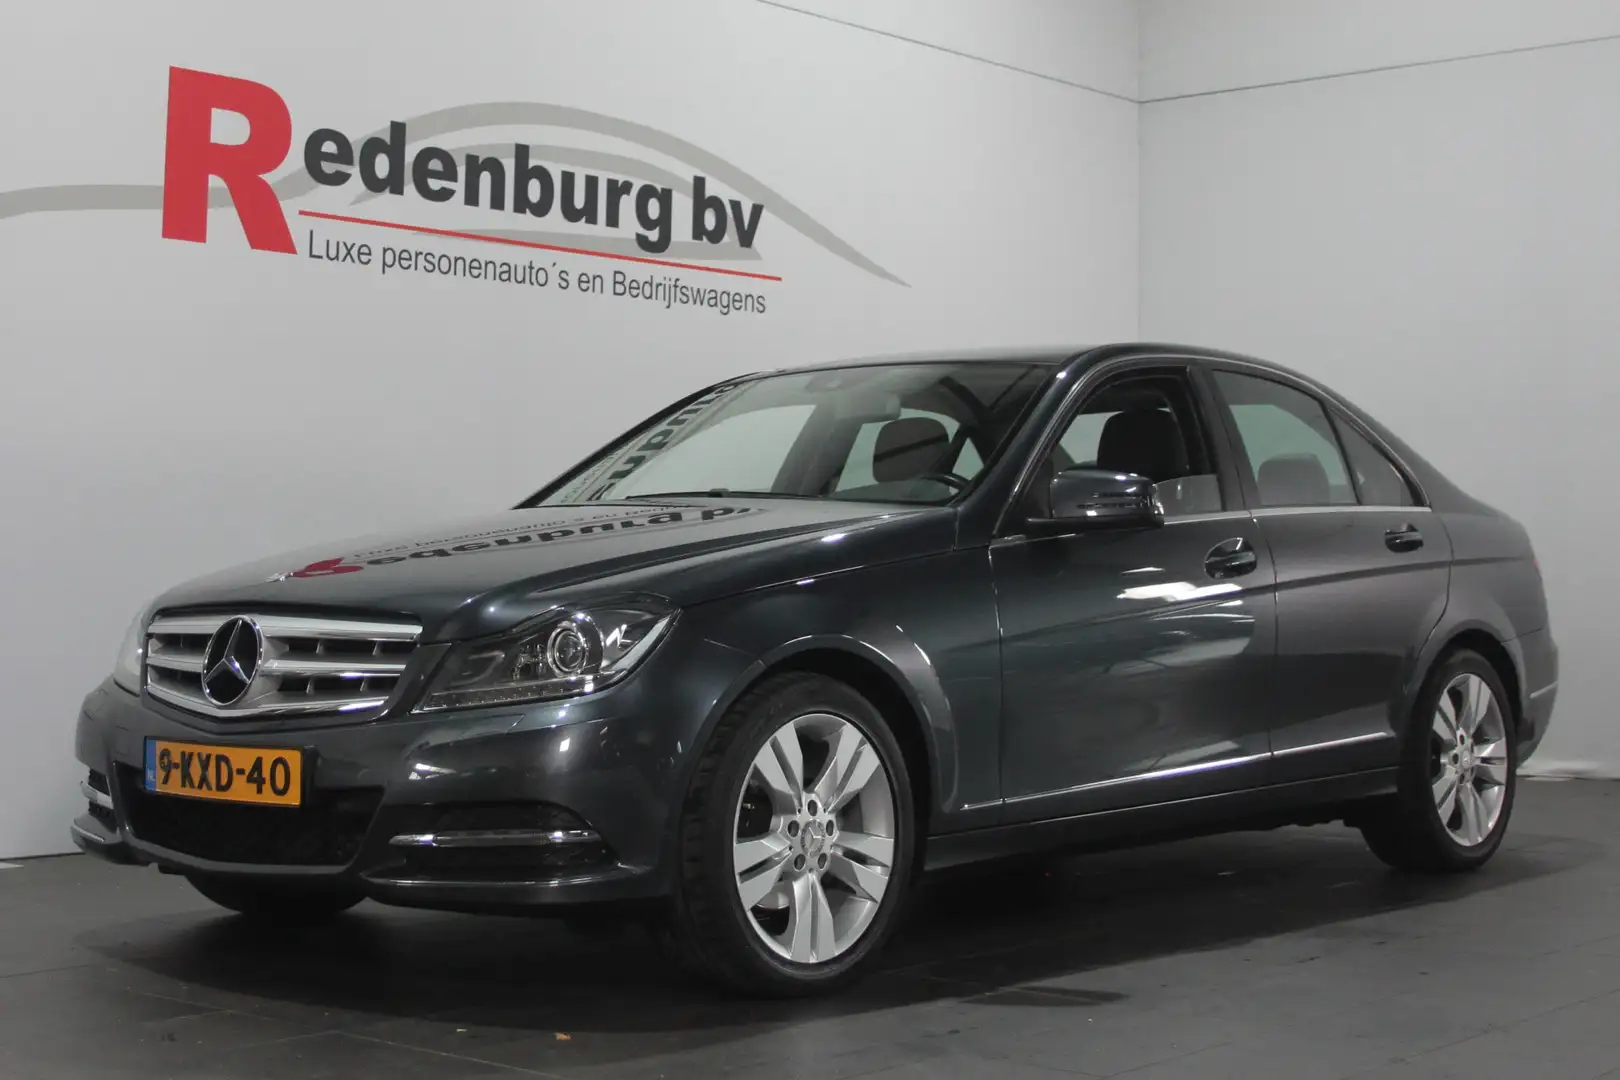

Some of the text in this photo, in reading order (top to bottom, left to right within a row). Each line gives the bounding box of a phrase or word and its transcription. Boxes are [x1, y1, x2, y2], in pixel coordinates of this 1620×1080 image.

[162, 65, 764, 255] Redenburg bv
[308, 229, 372, 266] Luxe
[577, 271, 604, 294] en
[612, 270, 767, 315] Bedrijfswagens
[159, 748, 291, 796] 9-KXD-40
